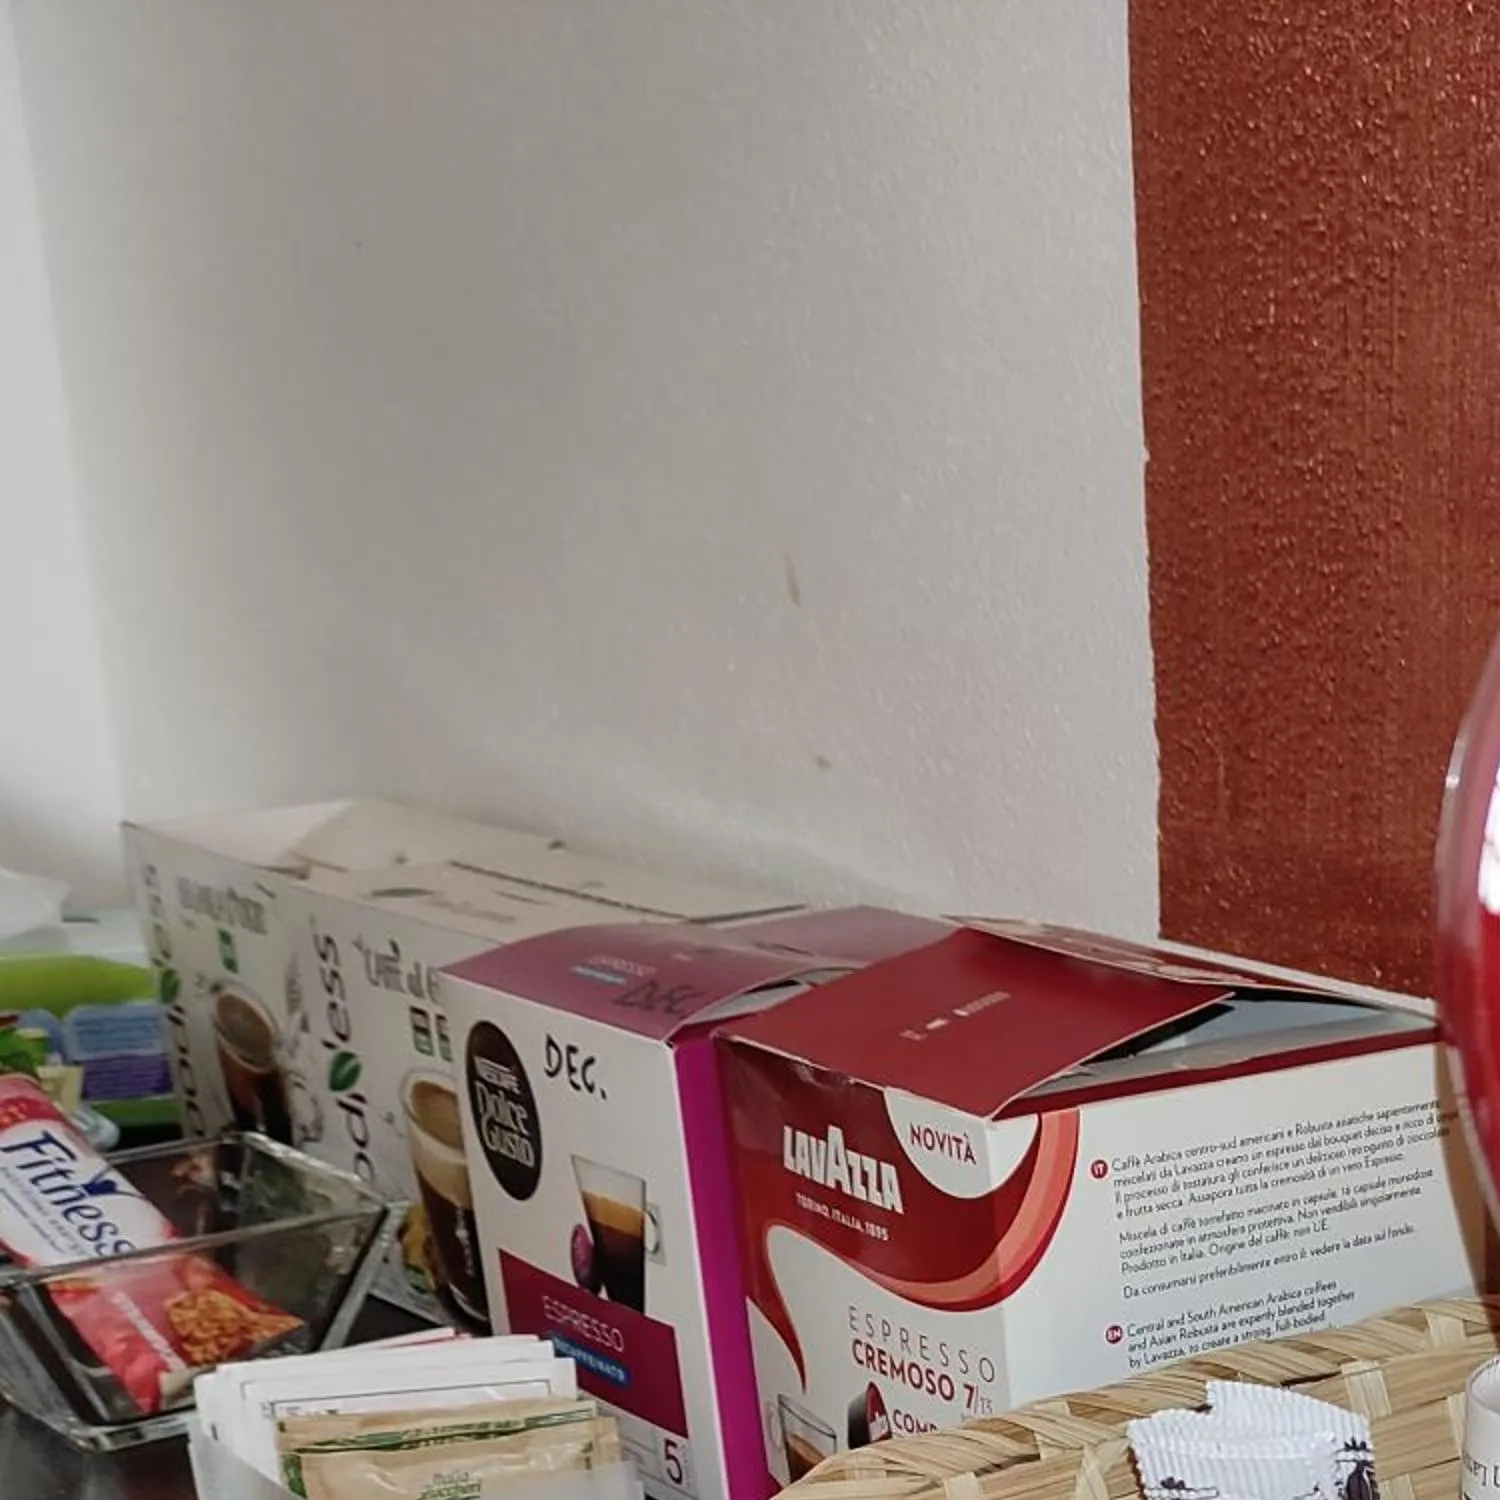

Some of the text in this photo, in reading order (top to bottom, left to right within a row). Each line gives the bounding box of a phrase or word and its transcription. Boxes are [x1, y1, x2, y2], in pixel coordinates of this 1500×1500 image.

[910, 1122, 977, 1165] NOVITÀ
[0, 1128, 137, 1256] Fitness
[783, 1124, 905, 1215] LAVAZZA
[542, 1296, 625, 1353] ESPRESSO
[1167, 1314, 1185, 1328] and
[1187, 1307, 1217, 1323] South
[849, 1305, 996, 1383] ESPRESSO
[1128, 1338, 1146, 1352] and
[1129, 1357, 1141, 1369] by
[852, 1339, 955, 1402] CREMOSO
[664, 1439, 683, 1485] 5
